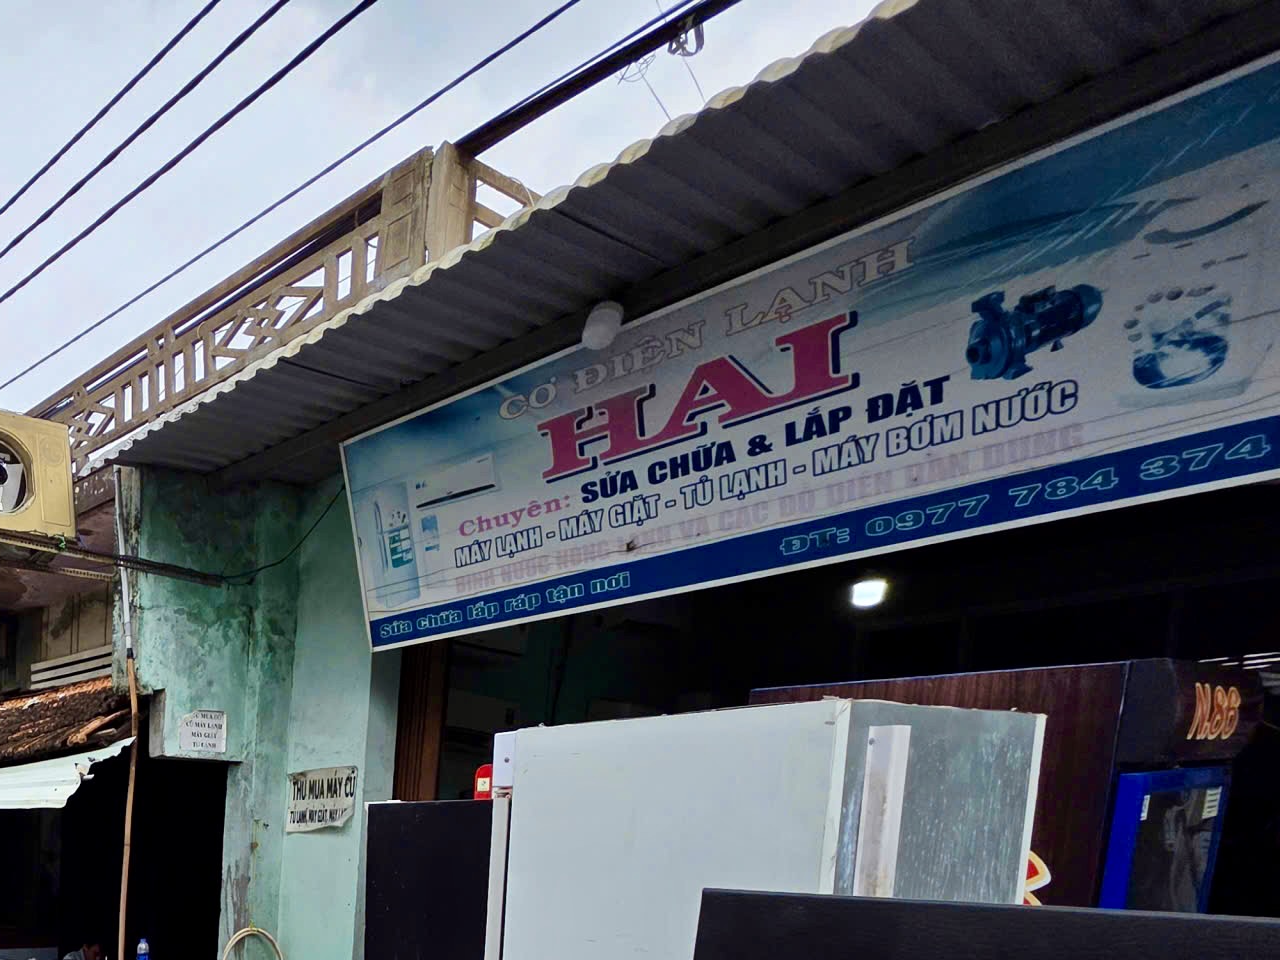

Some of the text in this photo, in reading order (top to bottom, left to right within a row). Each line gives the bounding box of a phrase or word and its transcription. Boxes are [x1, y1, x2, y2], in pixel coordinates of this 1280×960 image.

[497, 234, 916, 421] CƠ ĐIỆN LẠNH
[536, 309, 859, 484] HAI
[454, 538, 492, 569] MÁY
[495, 525, 544, 560] LẠNH
[559, 503, 604, 544] MÁY
[608, 490, 662, 531] GIẶT
[679, 474, 715, 509] TỦ
[719, 458, 788, 502] LẠNH
[813, 431, 879, 477] MÁY
[885, 408, 964, 459] BƠM
[973, 379, 1079, 437] NƯỚC
[458, 374, 951, 538] Chuyên: SỬA CHỮA & LẮP ĐẶT
[780, 433, 1271, 557] ĐT: 0977 784 374
[379, 570, 631, 638] Sửa chữa lắp ráp tận nơi
[292, 779, 307, 801] THU
[308, 777, 325, 801] MUA
[326, 769, 344, 799] MÁY
